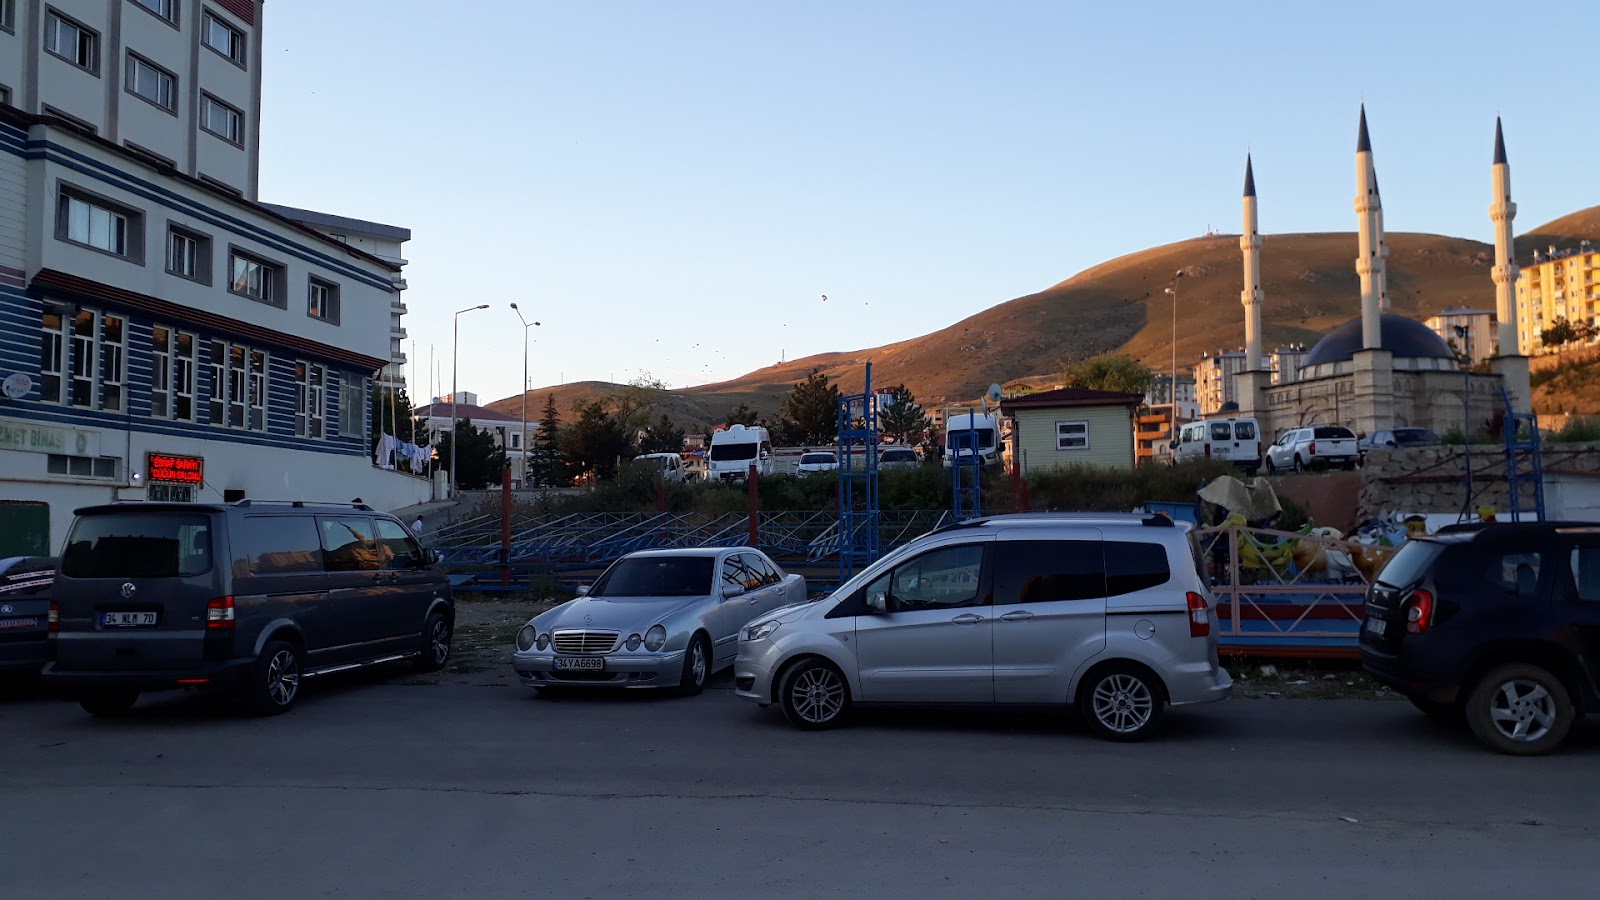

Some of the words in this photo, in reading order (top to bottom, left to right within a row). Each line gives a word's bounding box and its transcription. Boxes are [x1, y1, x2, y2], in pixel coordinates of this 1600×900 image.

[153, 458, 175, 468] ESNAF
[175, 460, 198, 470] SARAYI
[106, 613, 116, 624] 34
[143, 613, 154, 624] 70
